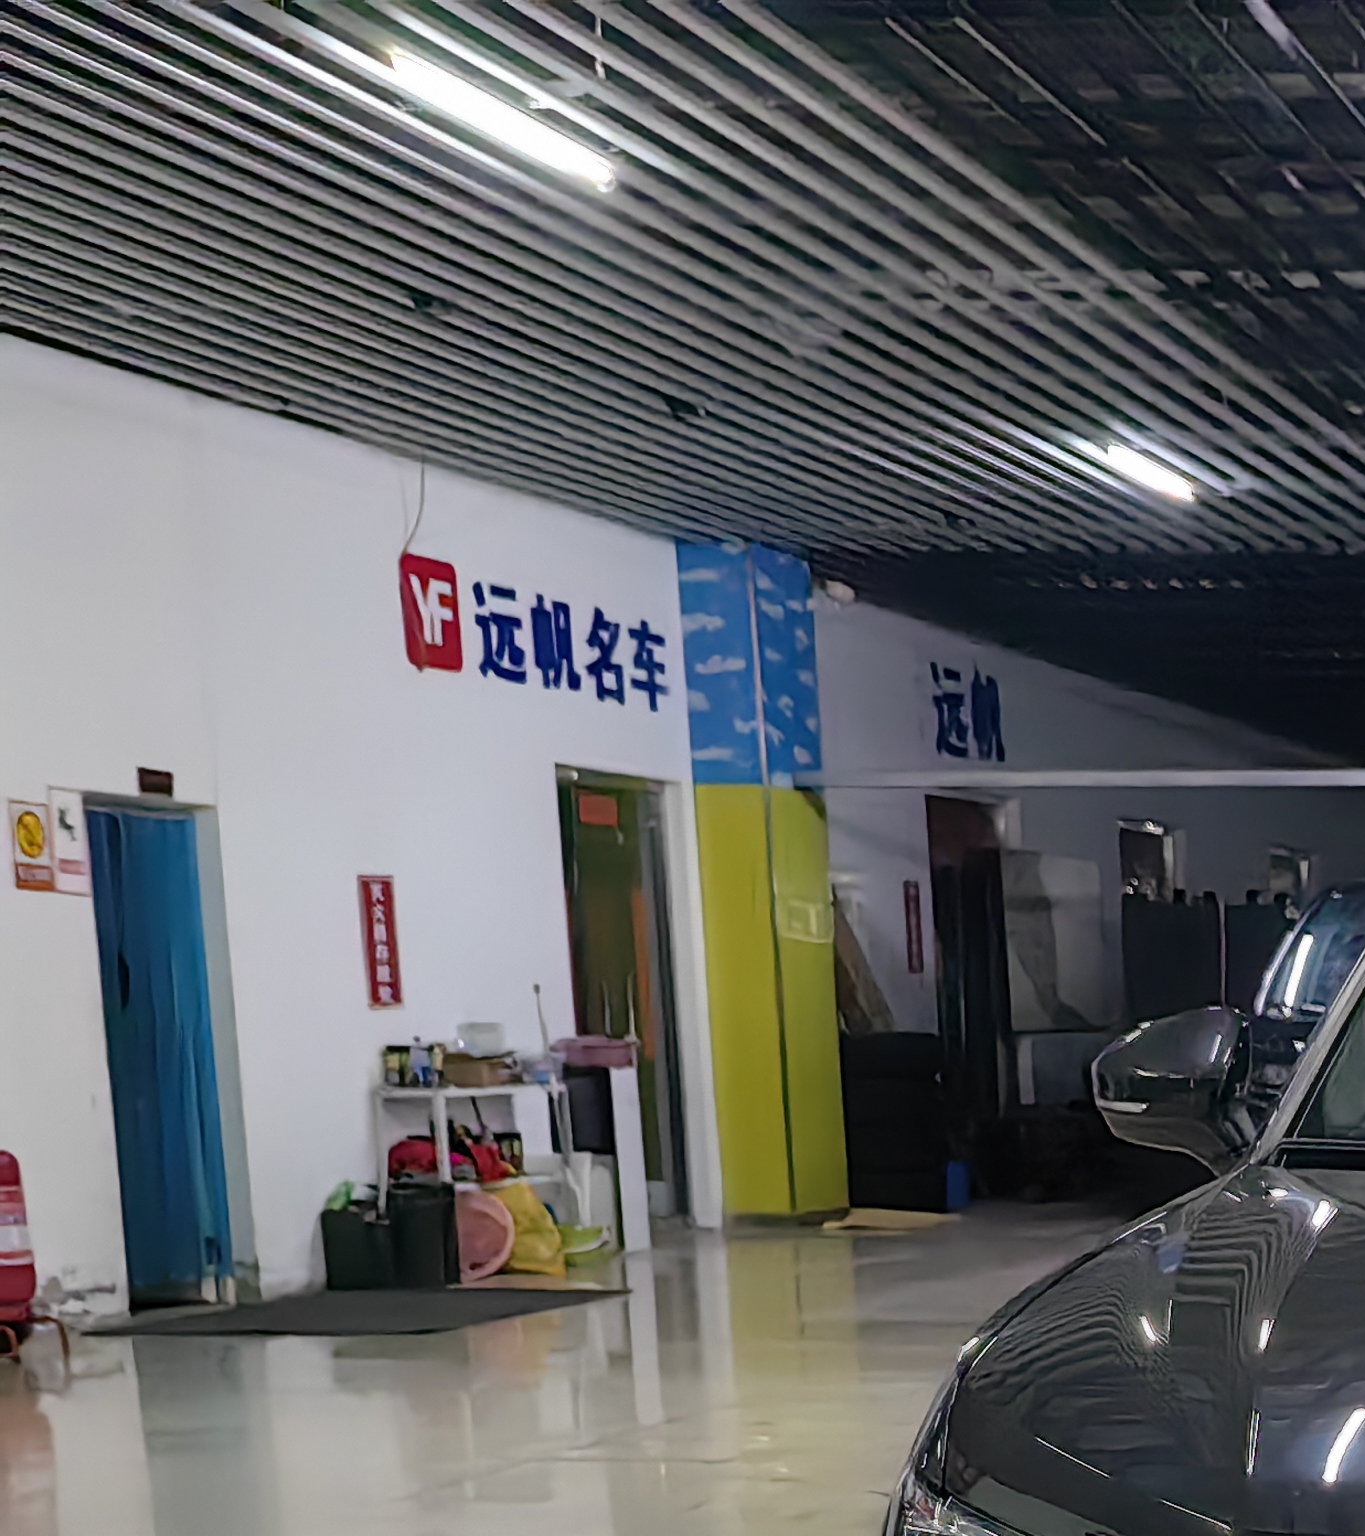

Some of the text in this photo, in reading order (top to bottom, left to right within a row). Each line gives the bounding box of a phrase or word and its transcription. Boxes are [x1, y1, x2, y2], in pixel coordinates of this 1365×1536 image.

[408, 573, 455, 647] YF
[472, 581, 669, 713] 远帆名车
